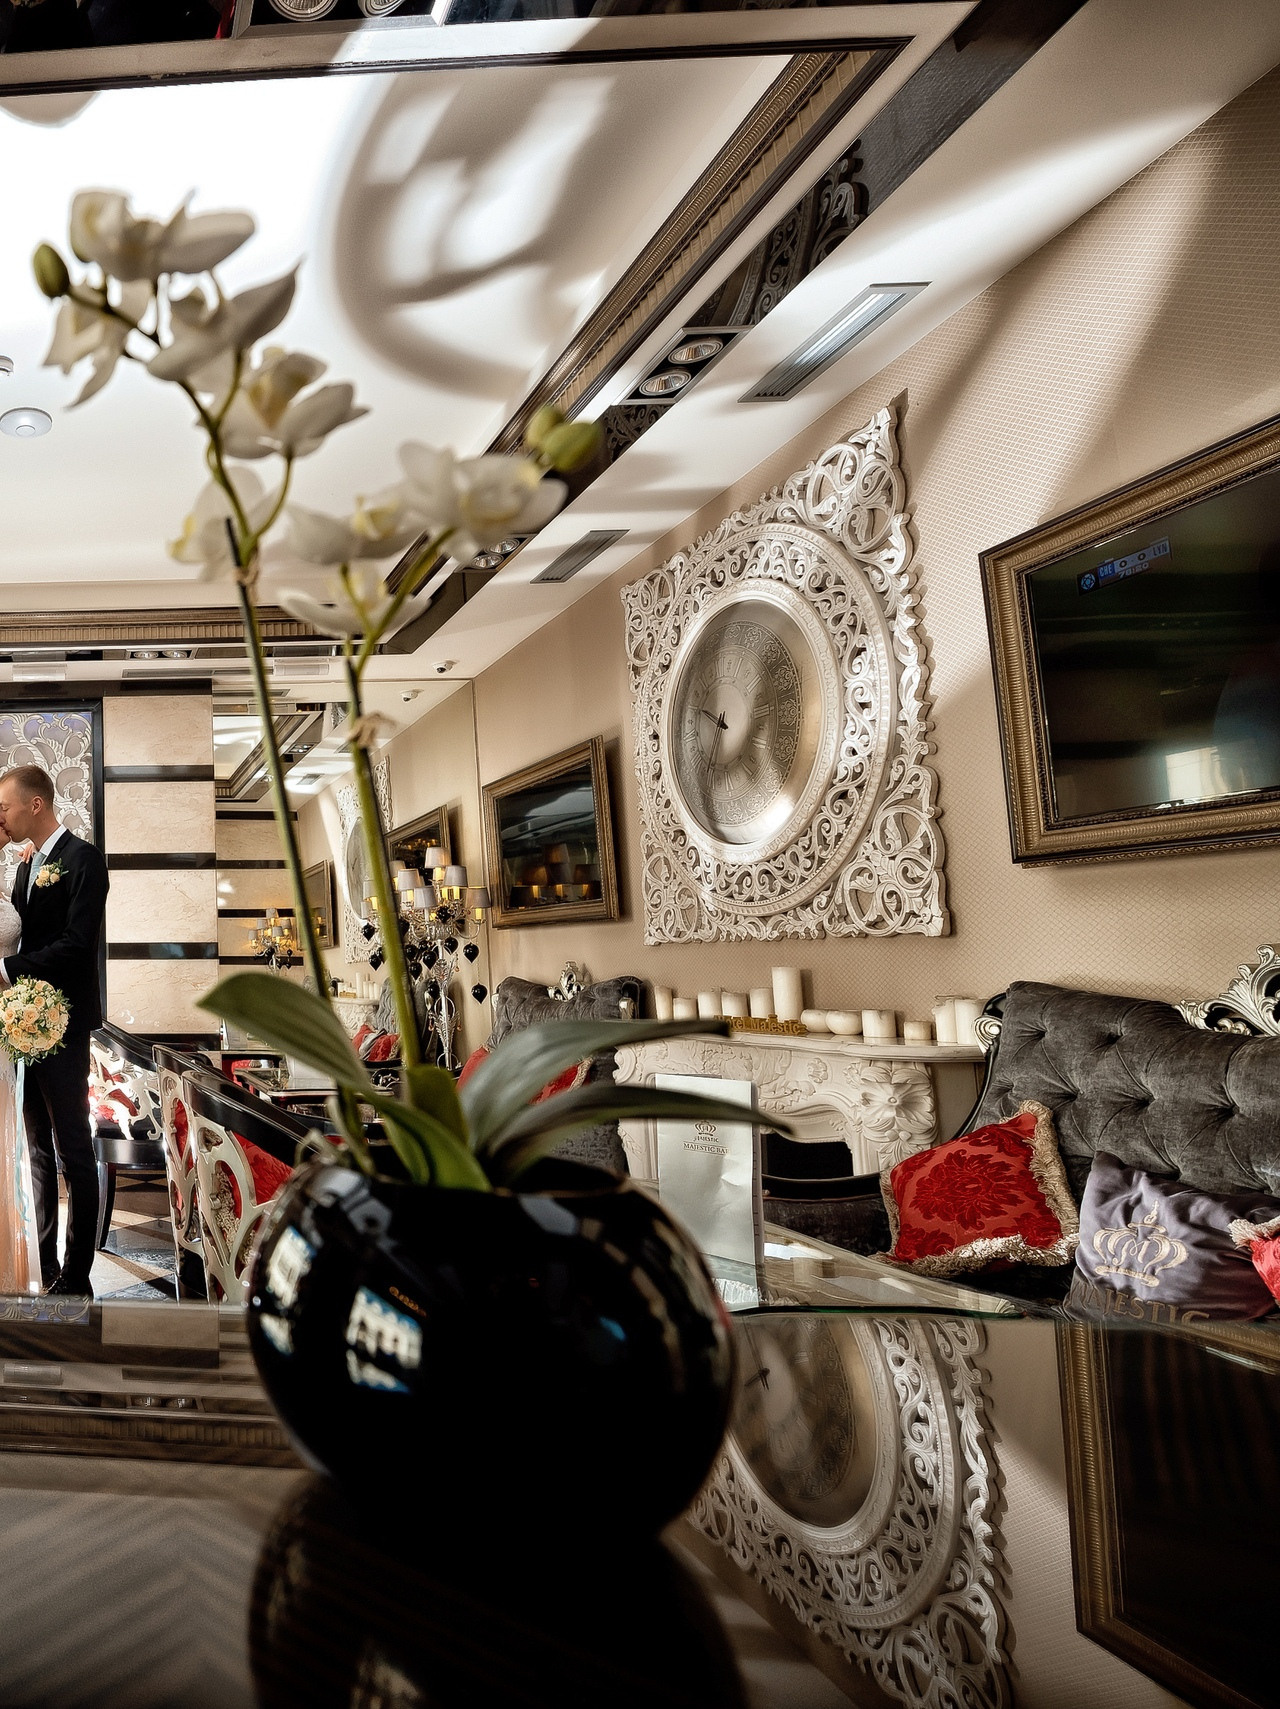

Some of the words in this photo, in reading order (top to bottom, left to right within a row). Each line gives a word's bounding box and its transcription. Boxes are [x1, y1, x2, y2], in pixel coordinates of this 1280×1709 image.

[1099, 563, 1113, 577] CHE
[750, 1016, 800, 1035] Majestic
[683, 1142, 716, 1153] MAJESTIC
